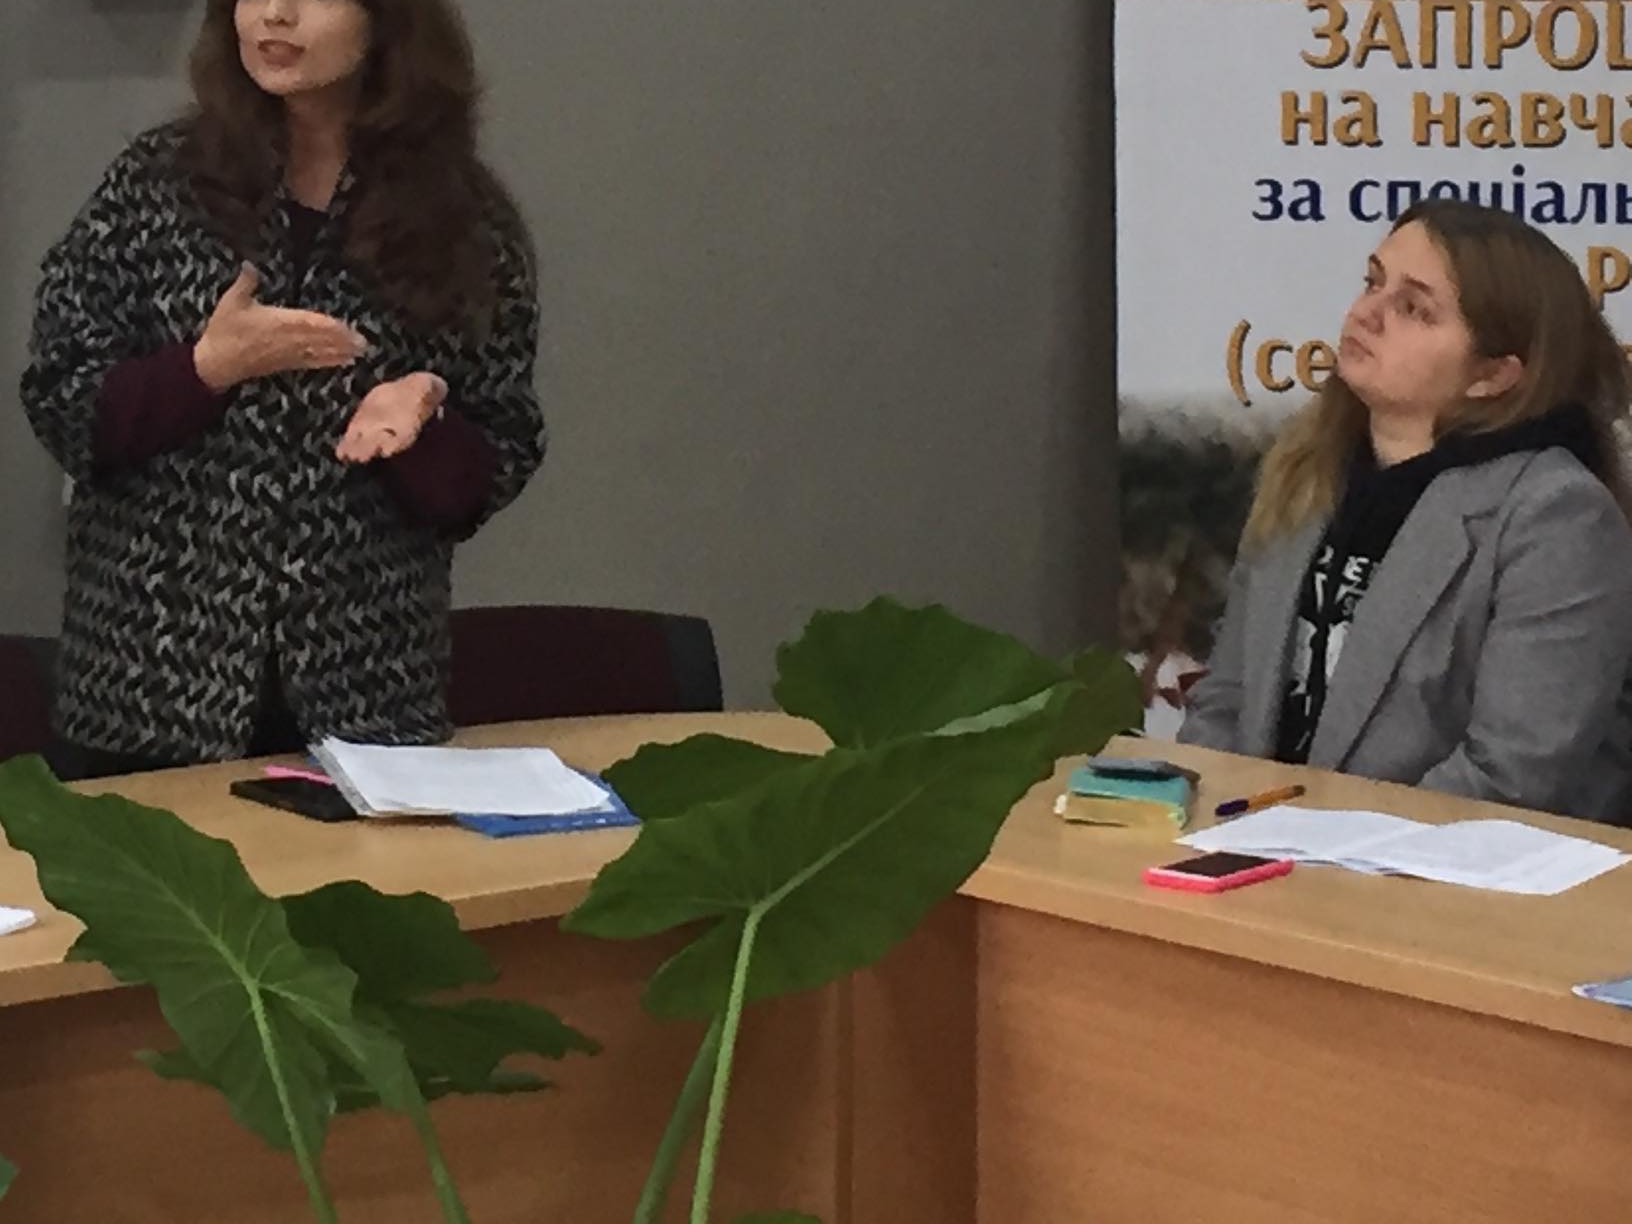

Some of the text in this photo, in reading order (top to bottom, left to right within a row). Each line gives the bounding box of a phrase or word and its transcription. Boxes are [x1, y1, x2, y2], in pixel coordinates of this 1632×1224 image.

[1279, 90, 1632, 149] на навч
[1252, 178, 1325, 222] за
